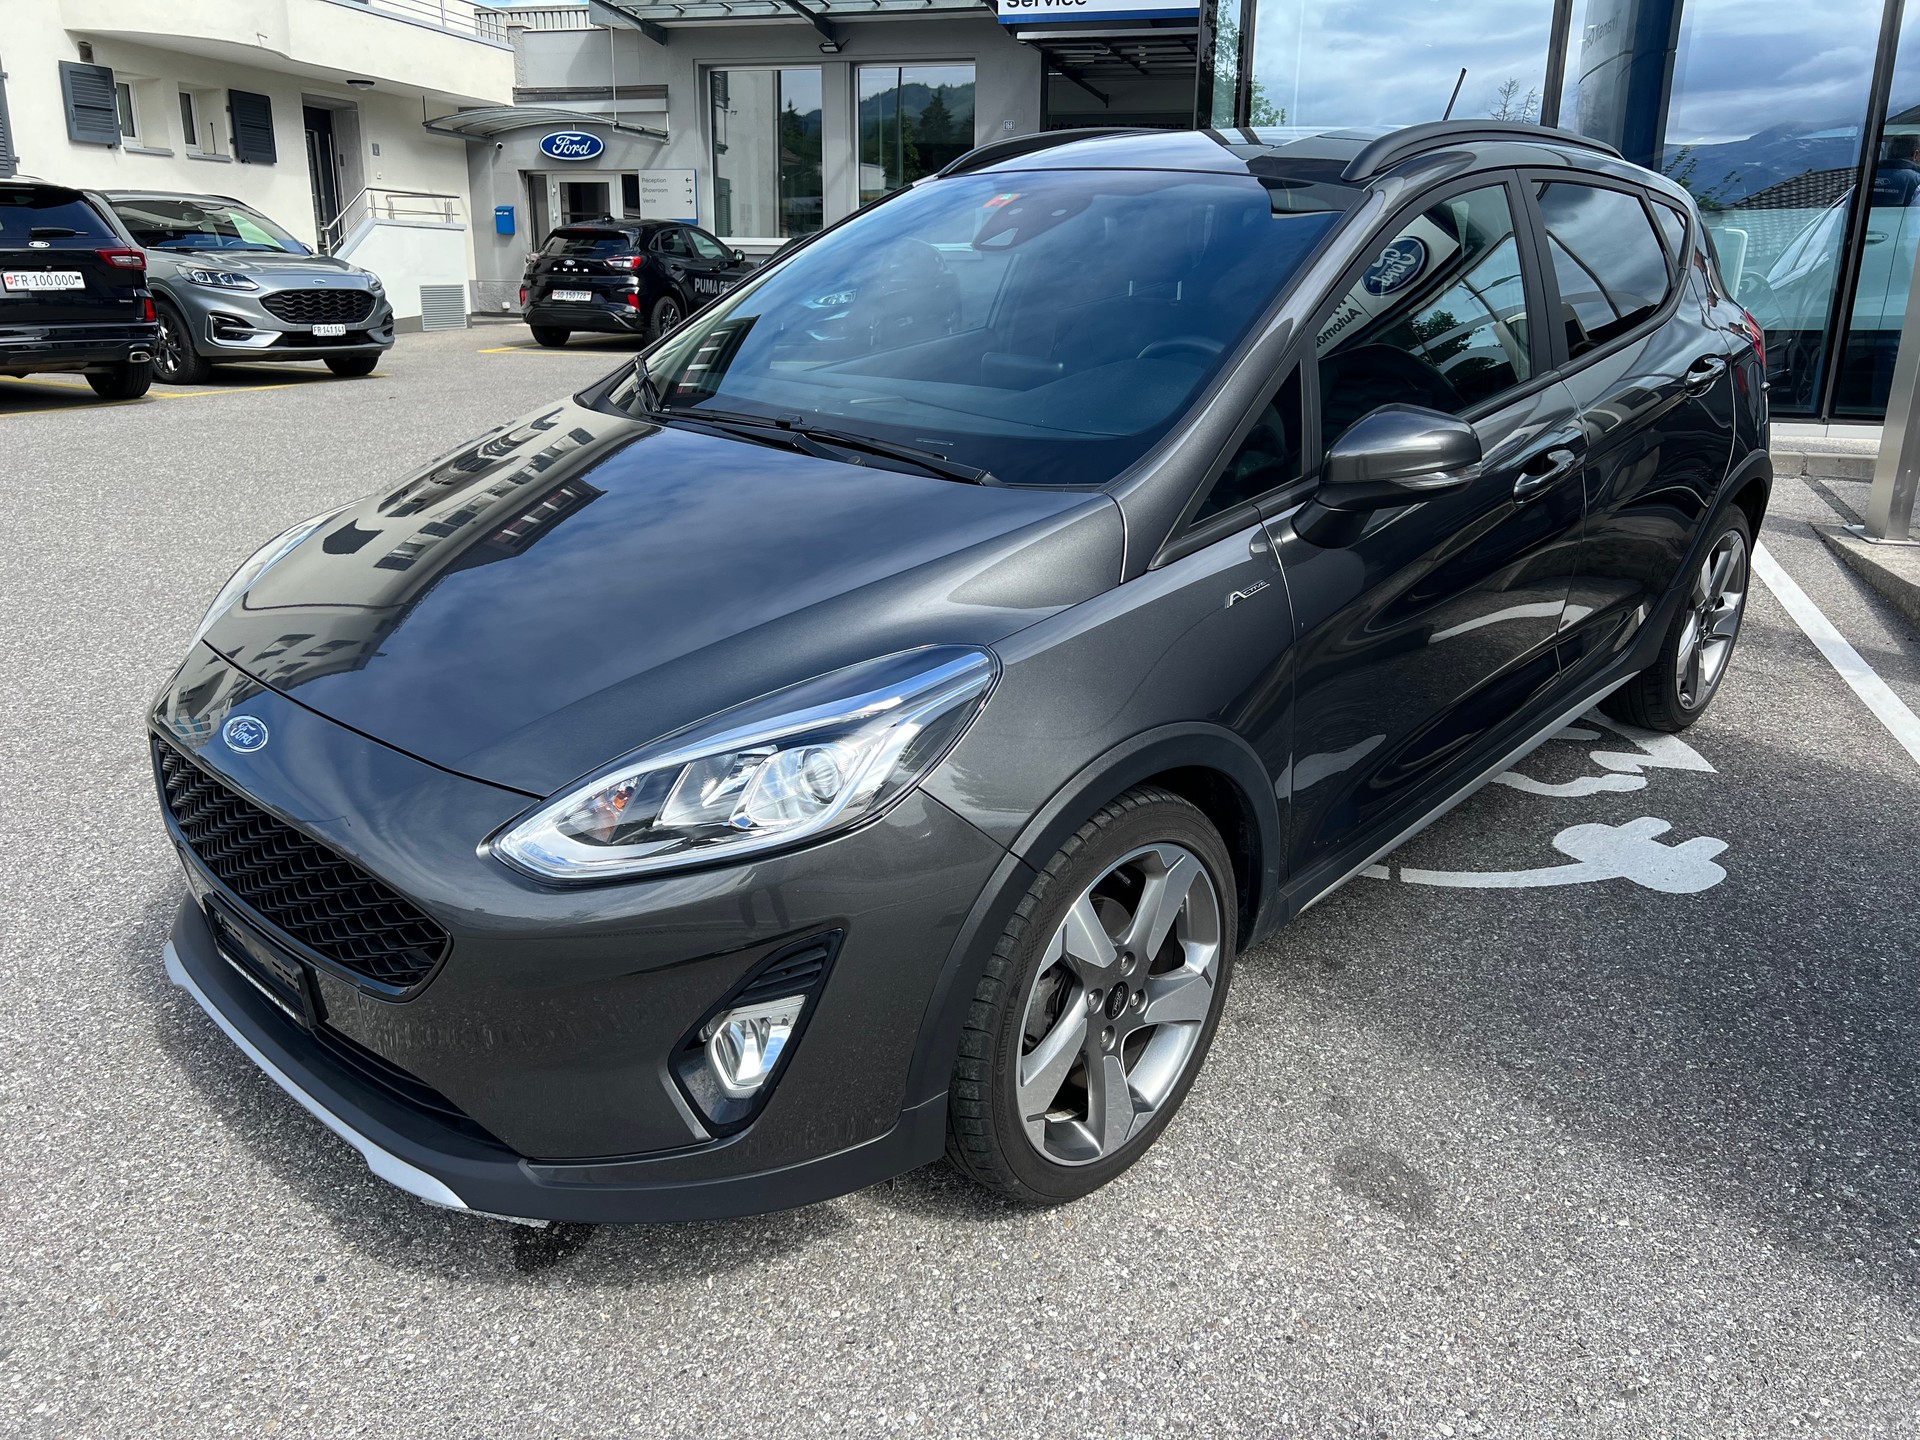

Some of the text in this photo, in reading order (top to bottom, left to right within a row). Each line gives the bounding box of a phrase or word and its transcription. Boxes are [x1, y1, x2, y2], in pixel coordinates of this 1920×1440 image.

[552, 135, 591, 155] Ford
[694, 277, 718, 294] PUMA
[229, 721, 259, 745] Ford
